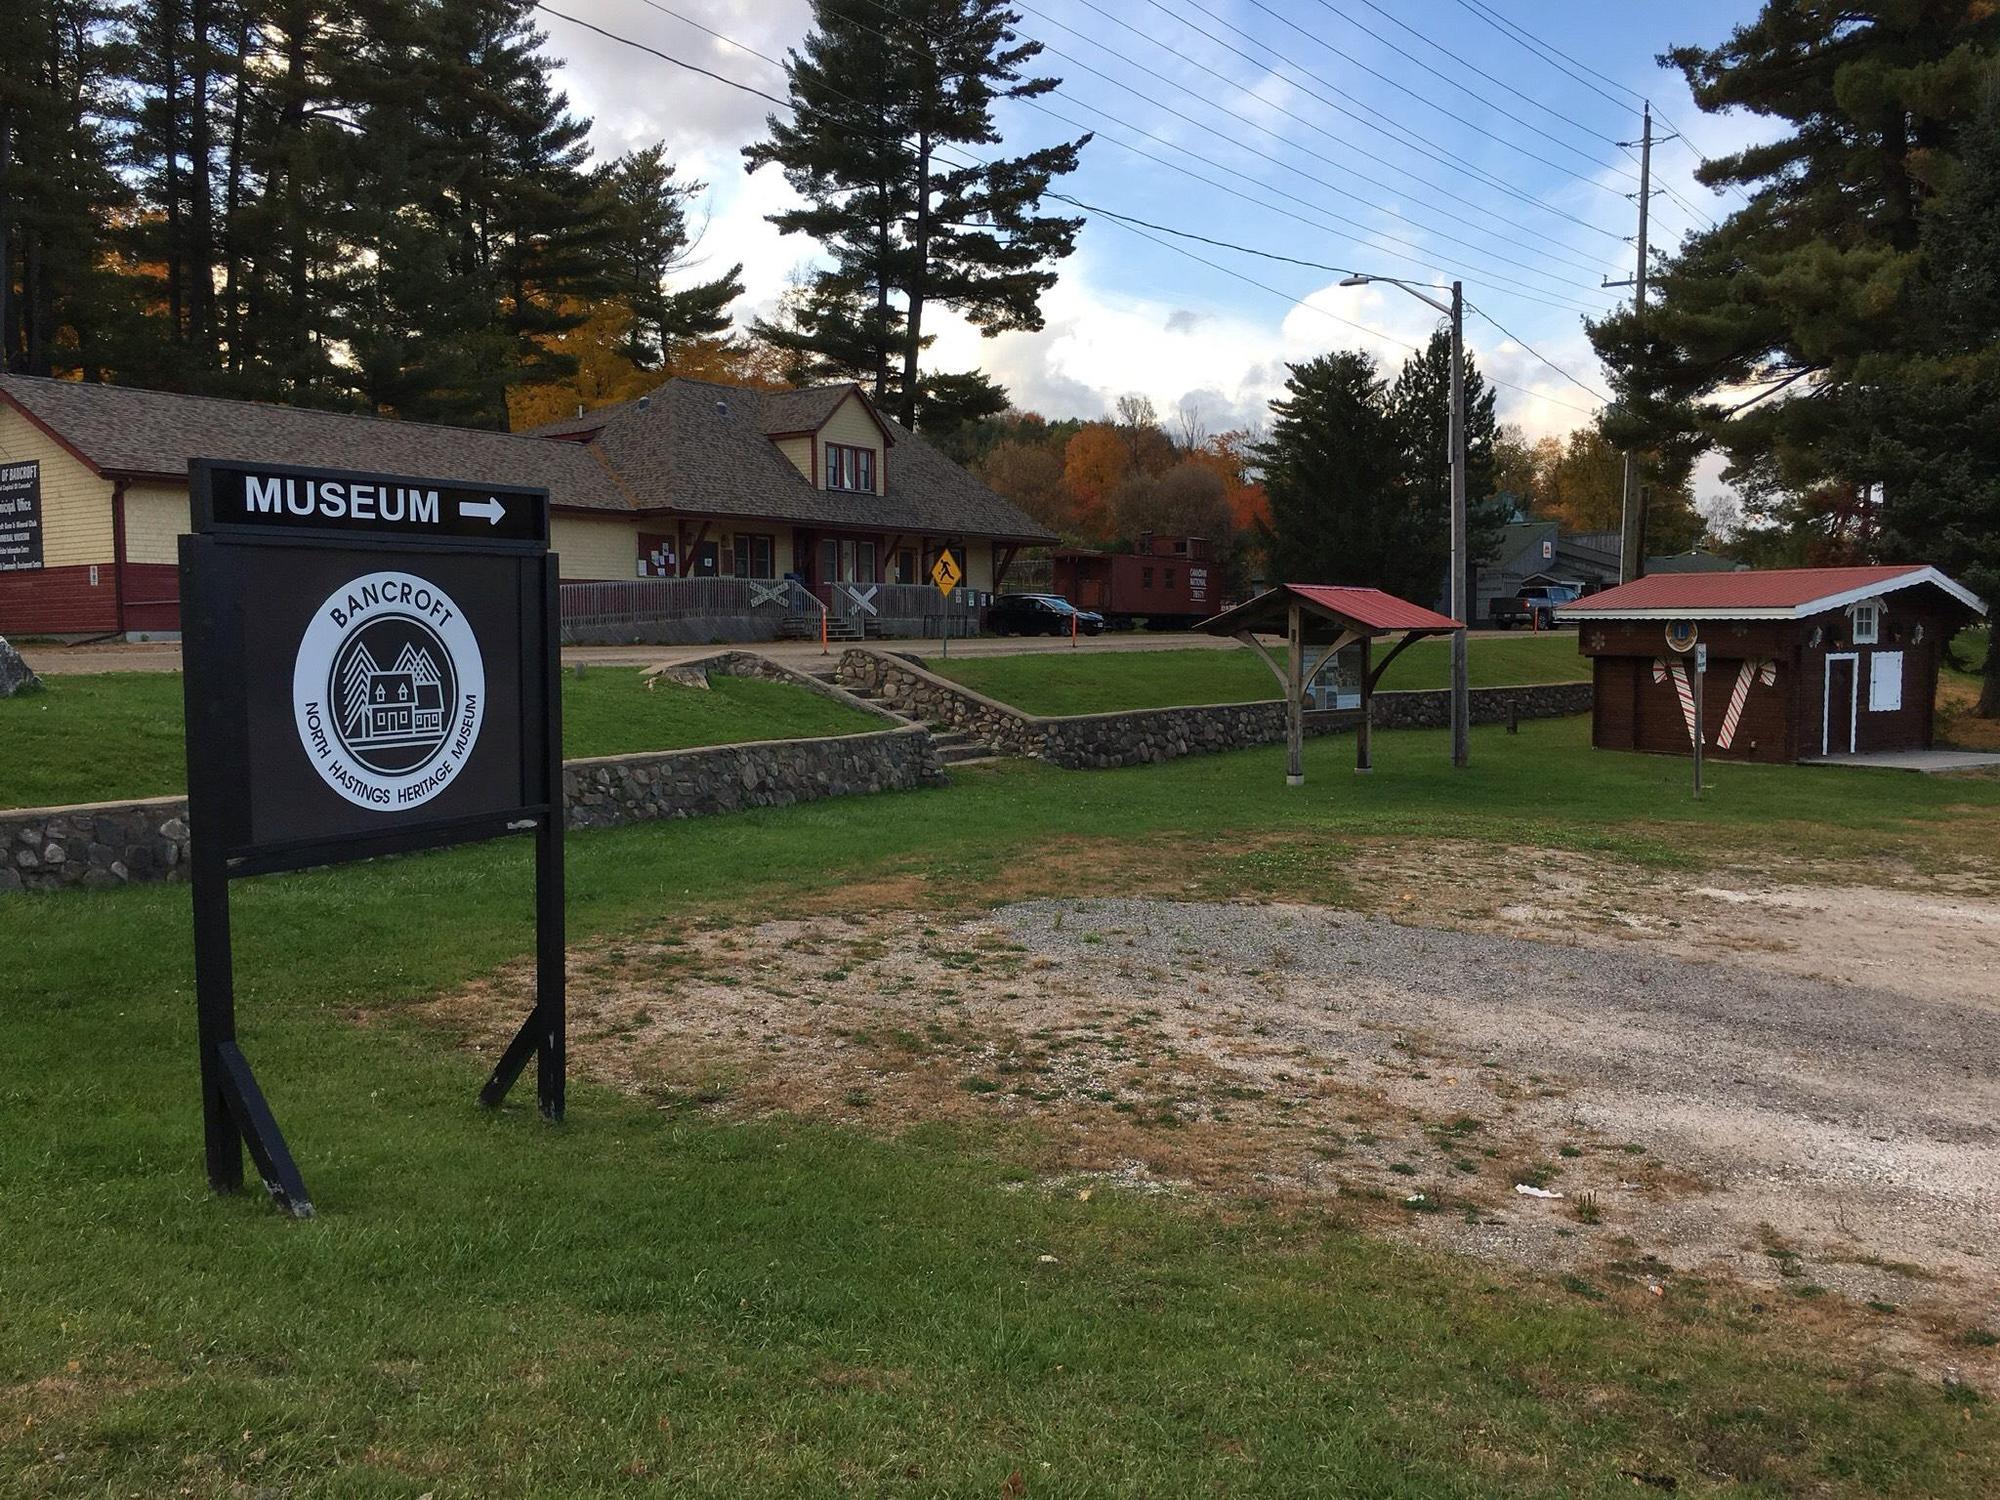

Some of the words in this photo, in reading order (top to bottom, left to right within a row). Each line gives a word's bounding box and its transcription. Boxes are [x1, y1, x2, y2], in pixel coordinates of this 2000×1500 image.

[245, 476, 440, 523] MUSEUM
[329, 580, 453, 629] BANCROFT
[305, 701, 332, 760] NORTH
[328, 760, 391, 804] HASTINGS
[397, 760, 454, 804] HERITAGE
[451, 694, 477, 760] MUSEUM
